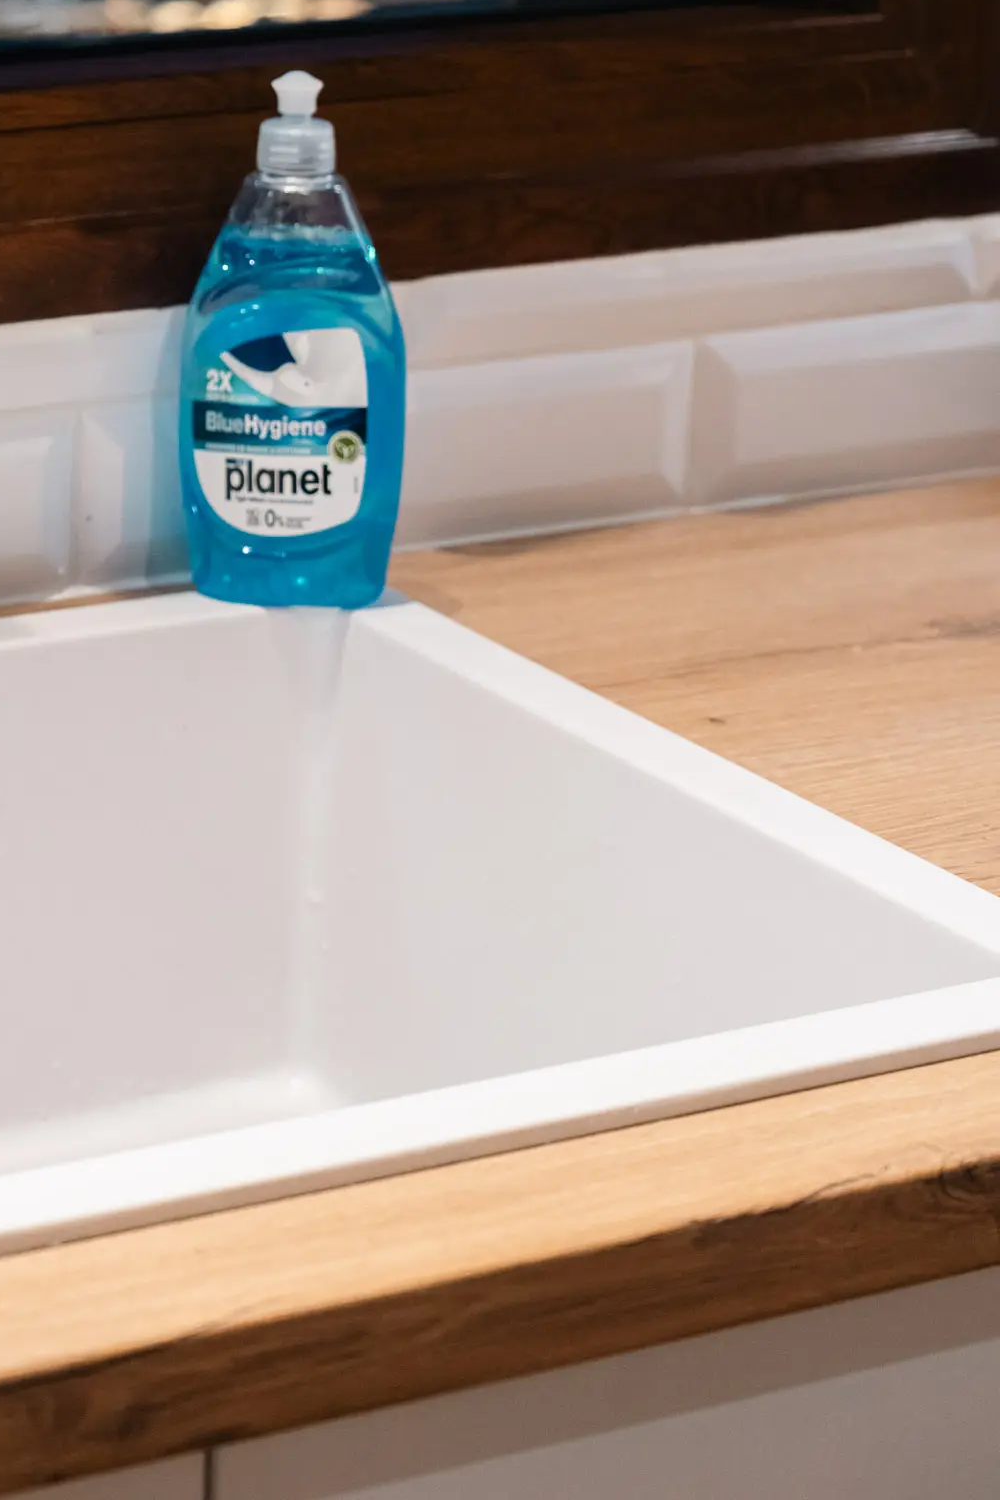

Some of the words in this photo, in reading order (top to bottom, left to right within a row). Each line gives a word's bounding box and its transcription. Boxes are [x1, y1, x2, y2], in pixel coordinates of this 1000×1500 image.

[206, 369, 233, 392] 2X
[205, 411, 326, 440] BlueHygiene
[226, 460, 331, 501] planet
